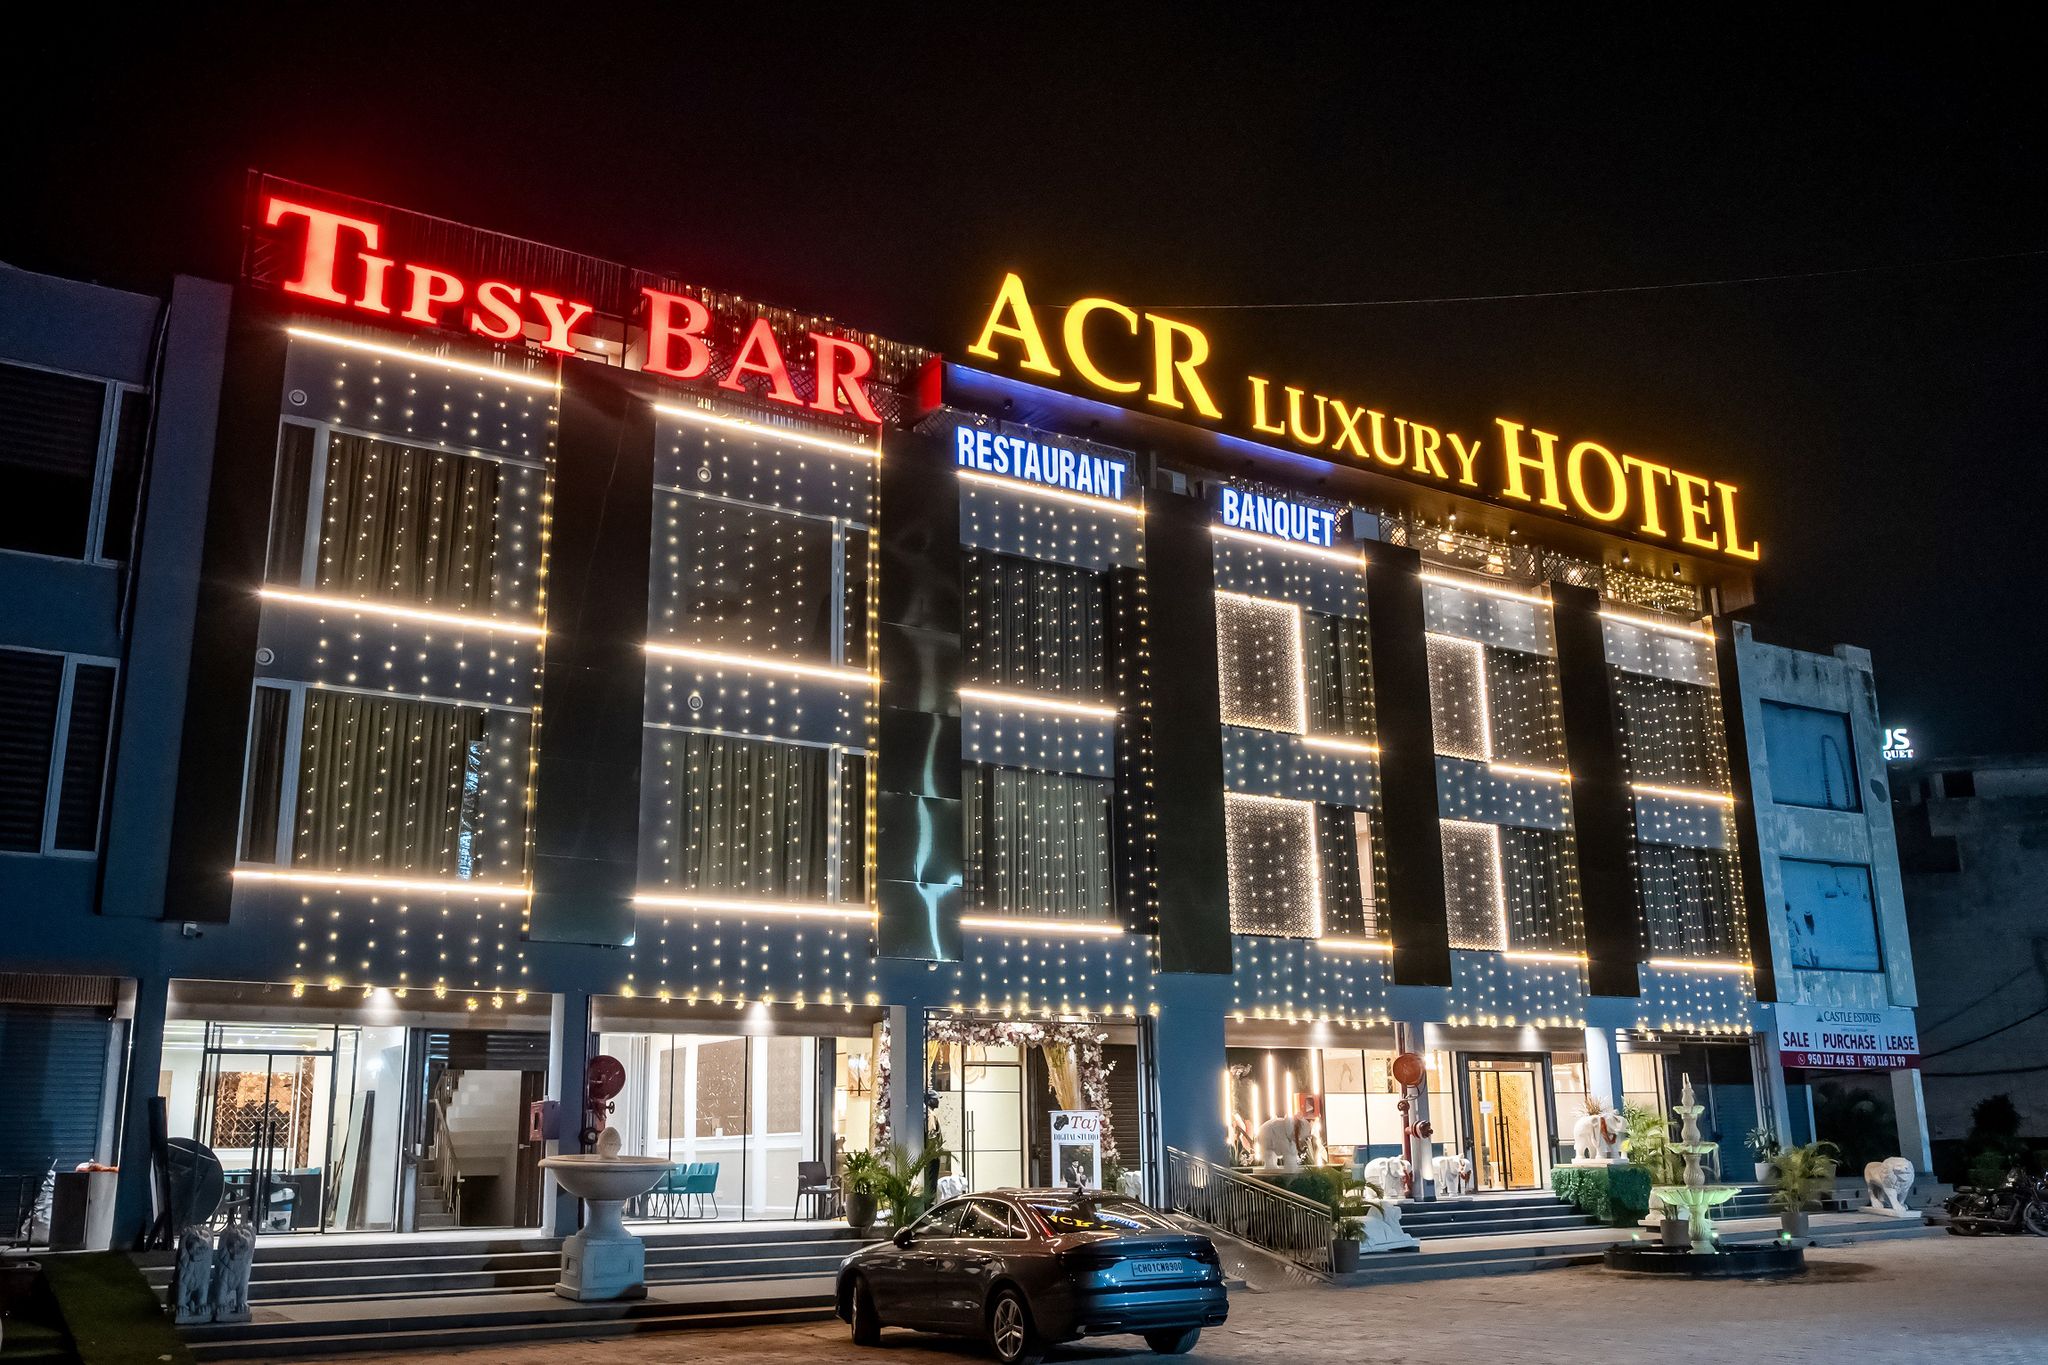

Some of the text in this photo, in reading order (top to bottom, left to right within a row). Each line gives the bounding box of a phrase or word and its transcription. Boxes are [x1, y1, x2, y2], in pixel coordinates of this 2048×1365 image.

[265, 197, 883, 424] TIPSY BAR
[968, 272, 1760, 562] ACR LUXURY HOTEL
[956, 426, 1126, 501] RESTAURANT
[1222, 488, 1336, 548] BANQUET
[1823, 1010, 1882, 1024] CASTLE ESTATES
[1783, 1032, 1915, 1051] SALE PURCHASE LEASE
[1807, 1054, 1821, 1066] 950
[1862, 1055, 1877, 1067] 950
[1070, 1115, 1098, 1132] Taj
[1077, 1133, 1099, 1141] STUDIO
